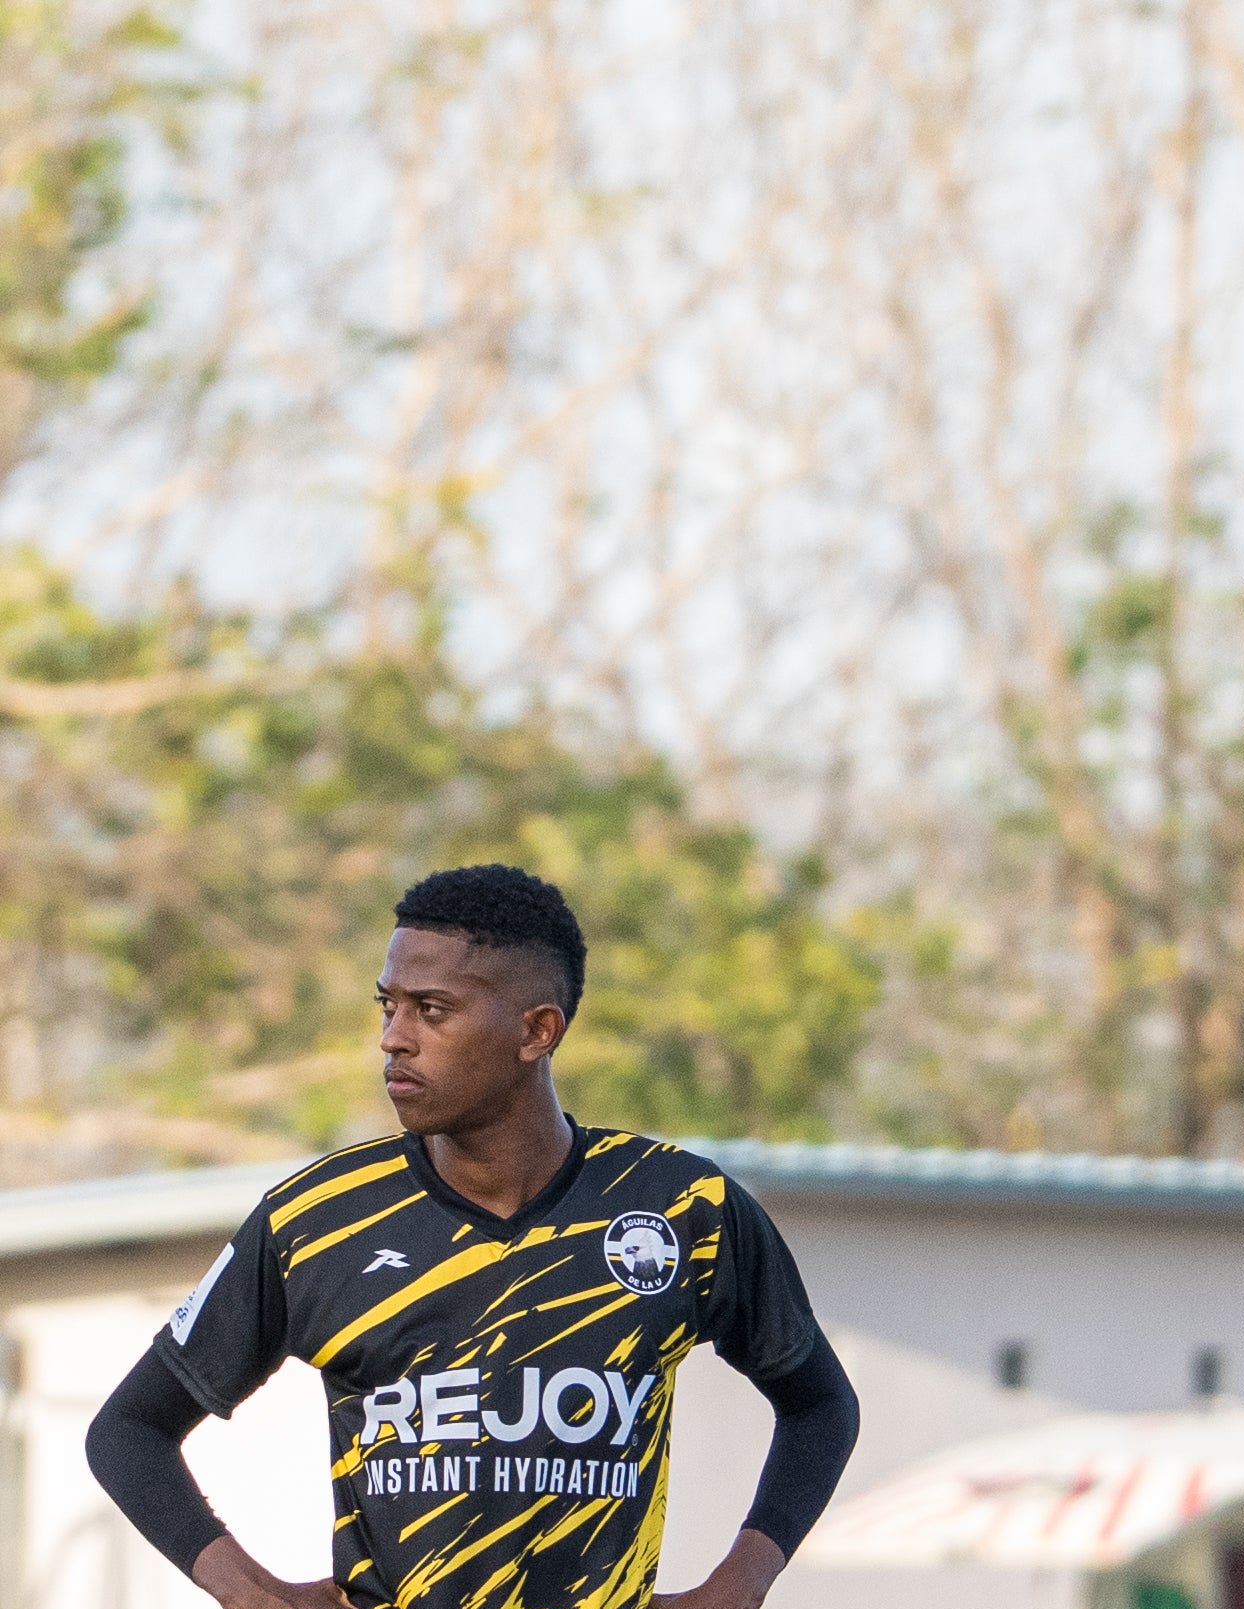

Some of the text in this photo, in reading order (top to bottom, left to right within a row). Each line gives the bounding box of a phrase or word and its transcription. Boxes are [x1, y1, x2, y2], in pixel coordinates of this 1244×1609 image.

[627, 1275, 662, 1289] DE LA U
[360, 1366, 657, 1446] REJOY
[364, 1456, 640, 1498] INSTANT HYDRATION
